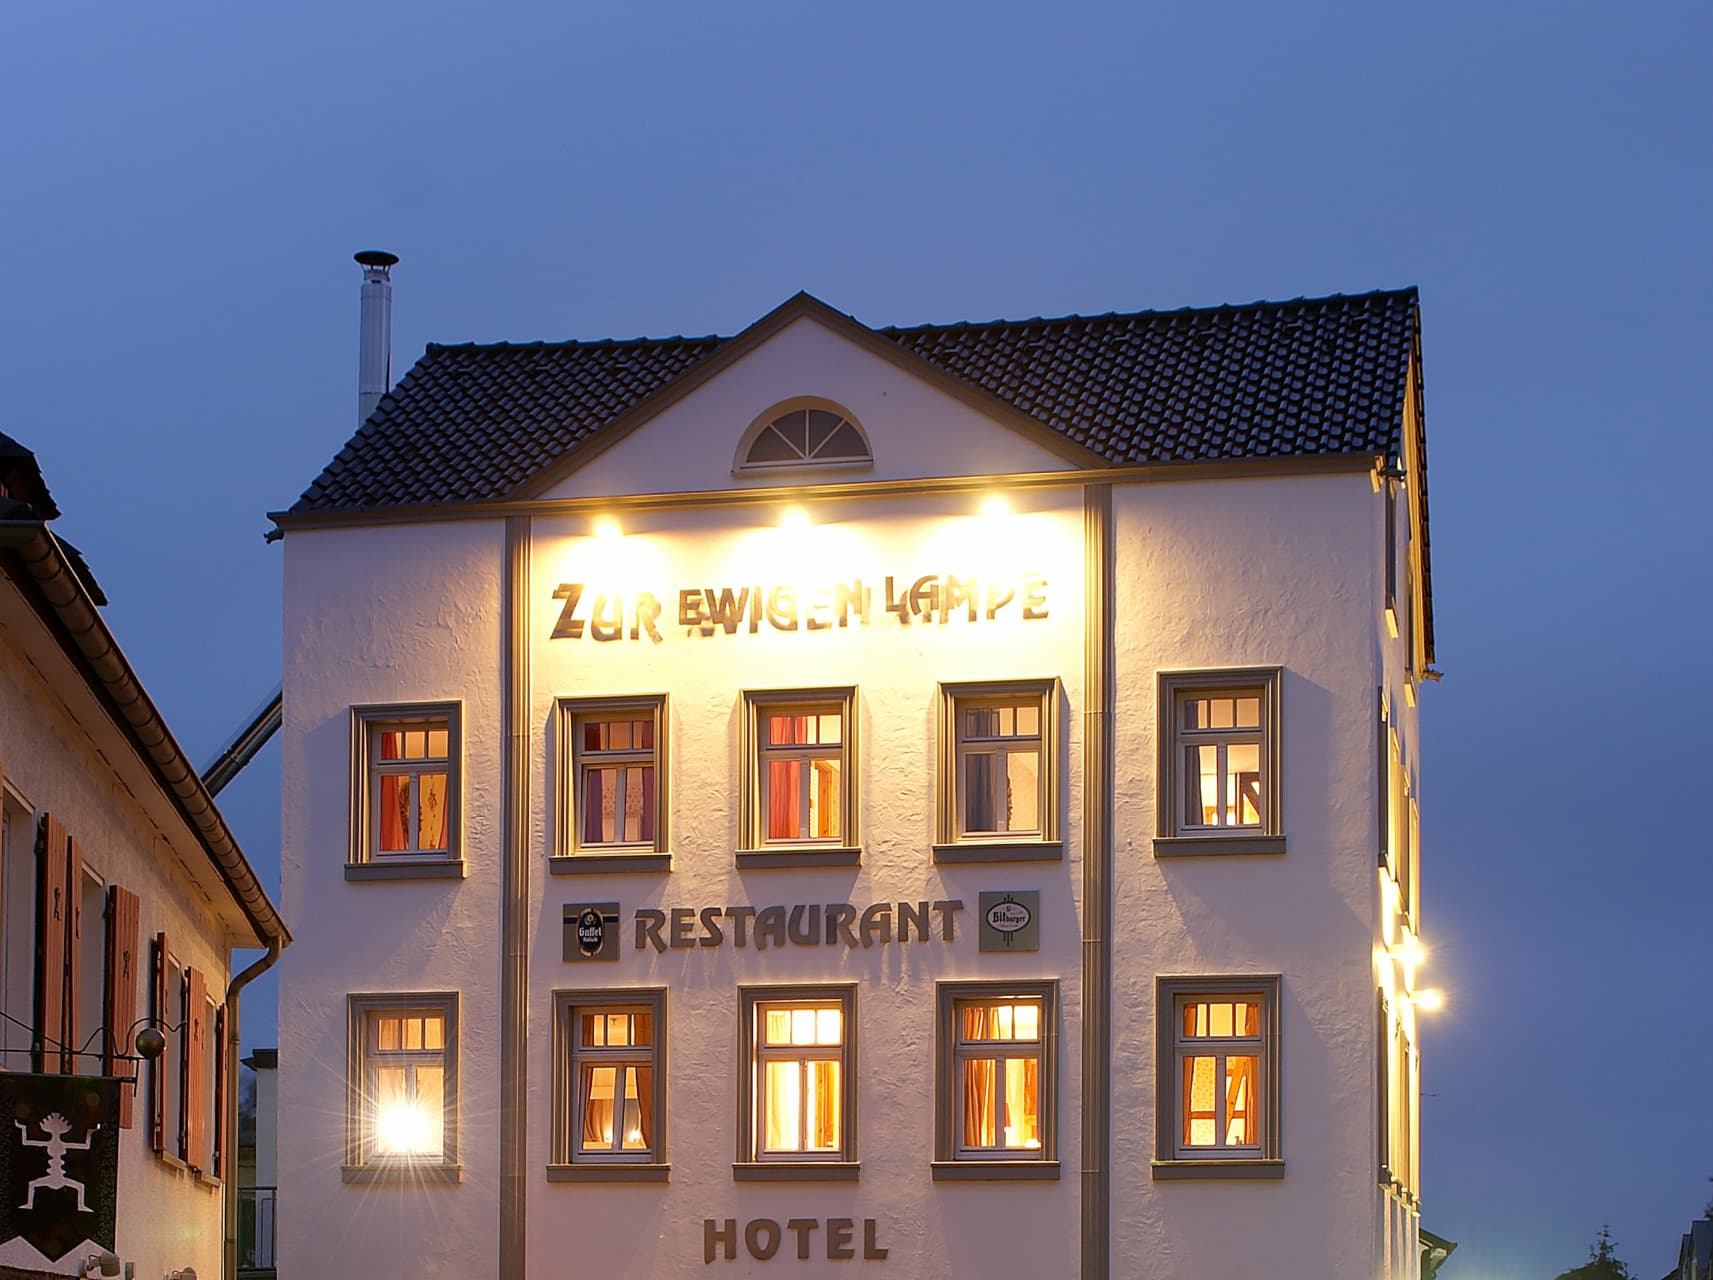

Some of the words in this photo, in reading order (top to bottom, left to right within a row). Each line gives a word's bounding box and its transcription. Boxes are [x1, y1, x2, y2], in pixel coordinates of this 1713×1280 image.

[550, 582, 664, 643] ZUR
[678, 582, 865, 637] EWIGEN
[884, 573, 1050, 625] LAMPE
[579, 926, 602, 937] Gaffel
[634, 900, 965, 953] RESTAURANT
[703, 1218, 889, 1265] HOTEL
